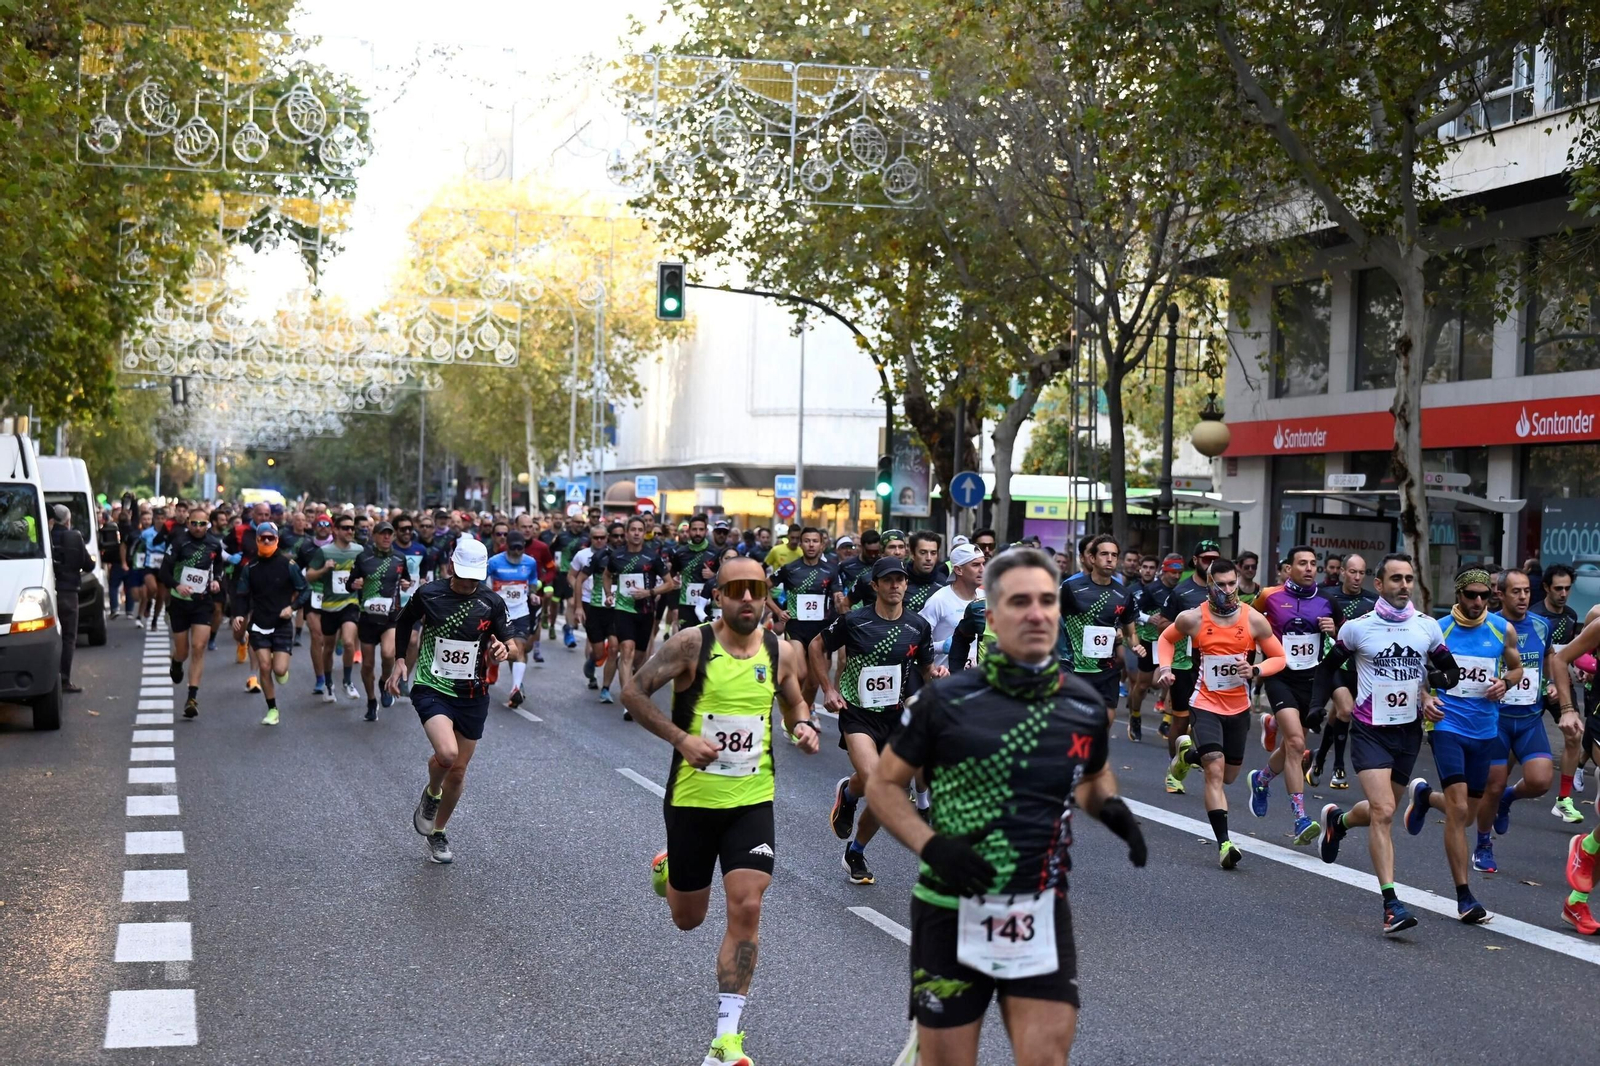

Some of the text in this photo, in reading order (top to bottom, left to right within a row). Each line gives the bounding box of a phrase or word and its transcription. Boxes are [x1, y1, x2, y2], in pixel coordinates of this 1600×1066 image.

[1532, 410, 1595, 436] Santander
[1284, 427, 1327, 448] Santander
[1311, 523, 1325, 535] La
[1310, 537, 1386, 551] HUMANIDAD
[186, 573, 204, 585] 569
[369, 603, 387, 613] 633
[805, 600, 818, 611] 25
[1093, 635, 1108, 646] 63
[441, 649, 470, 665] 385
[1290, 643, 1315, 657] 518
[1211, 664, 1238, 677] 156
[866, 676, 894, 692] 651
[1387, 692, 1408, 708] 92
[715, 731, 754, 753] 384
[980, 914, 1035, 943] 143
